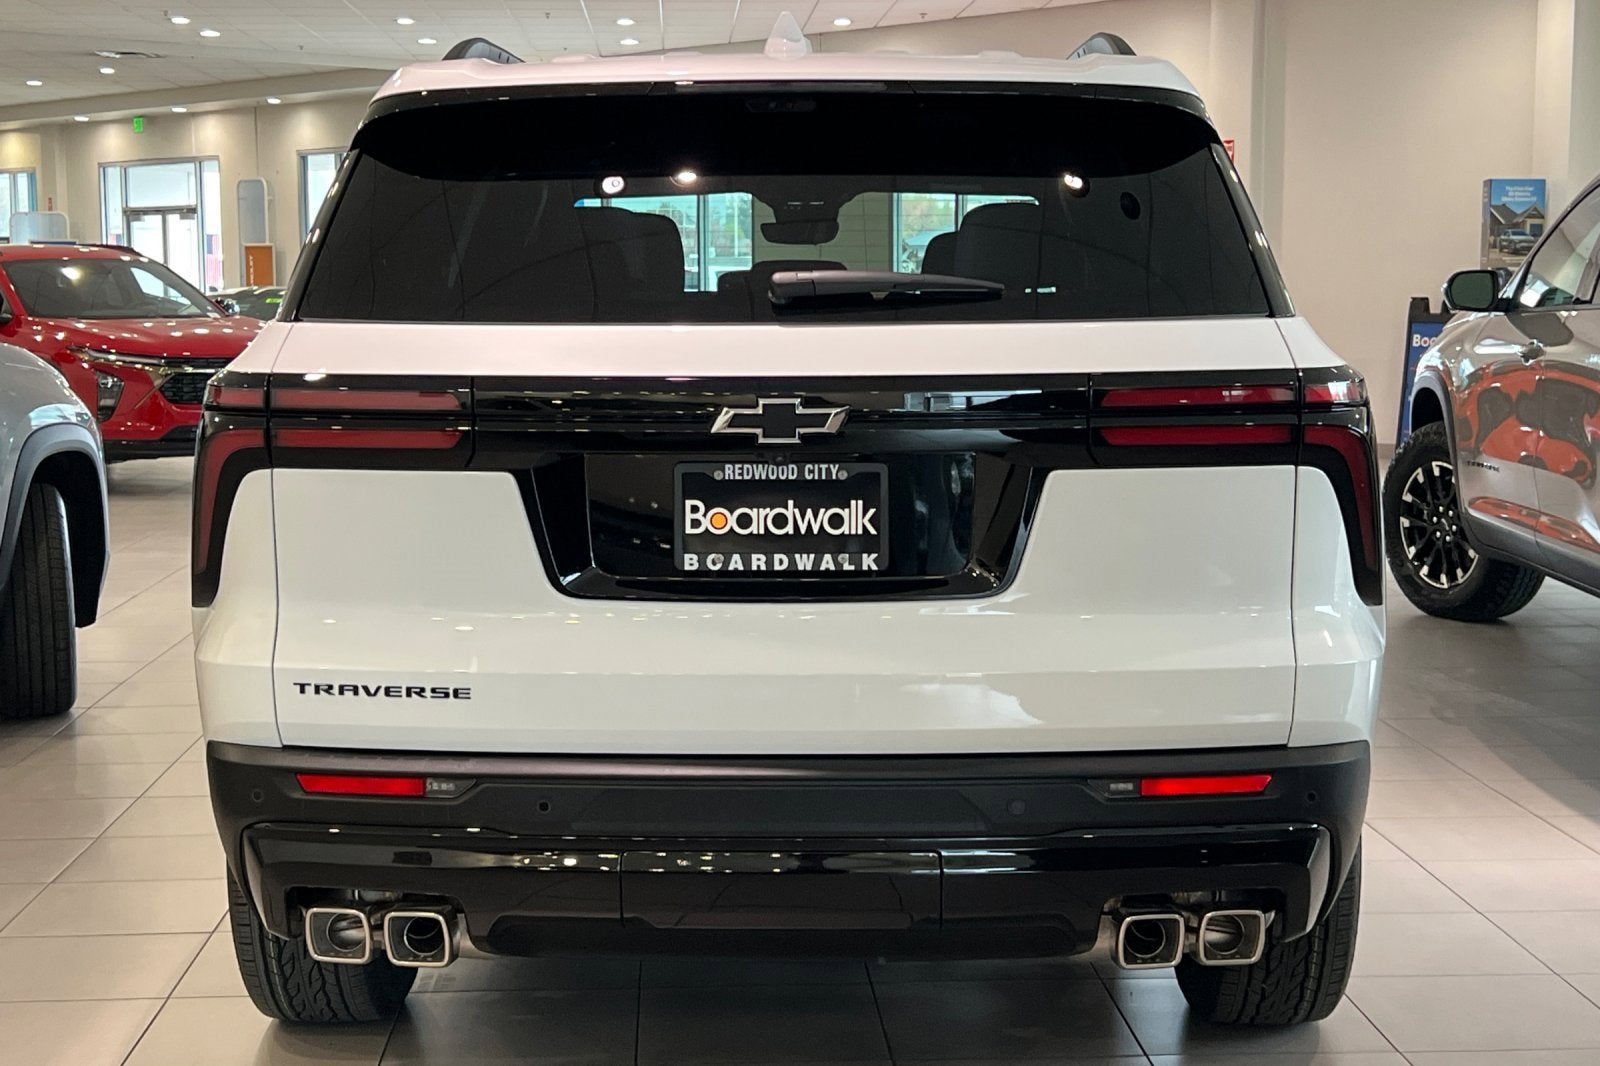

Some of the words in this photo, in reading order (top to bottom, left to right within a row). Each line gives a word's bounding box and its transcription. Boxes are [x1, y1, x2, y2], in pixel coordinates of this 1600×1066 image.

[724, 464, 798, 480] REDWOOD
[804, 464, 839, 480] CITY
[684, 499, 878, 535] Boardwalk
[293, 682, 472, 700] TRAVERSE
